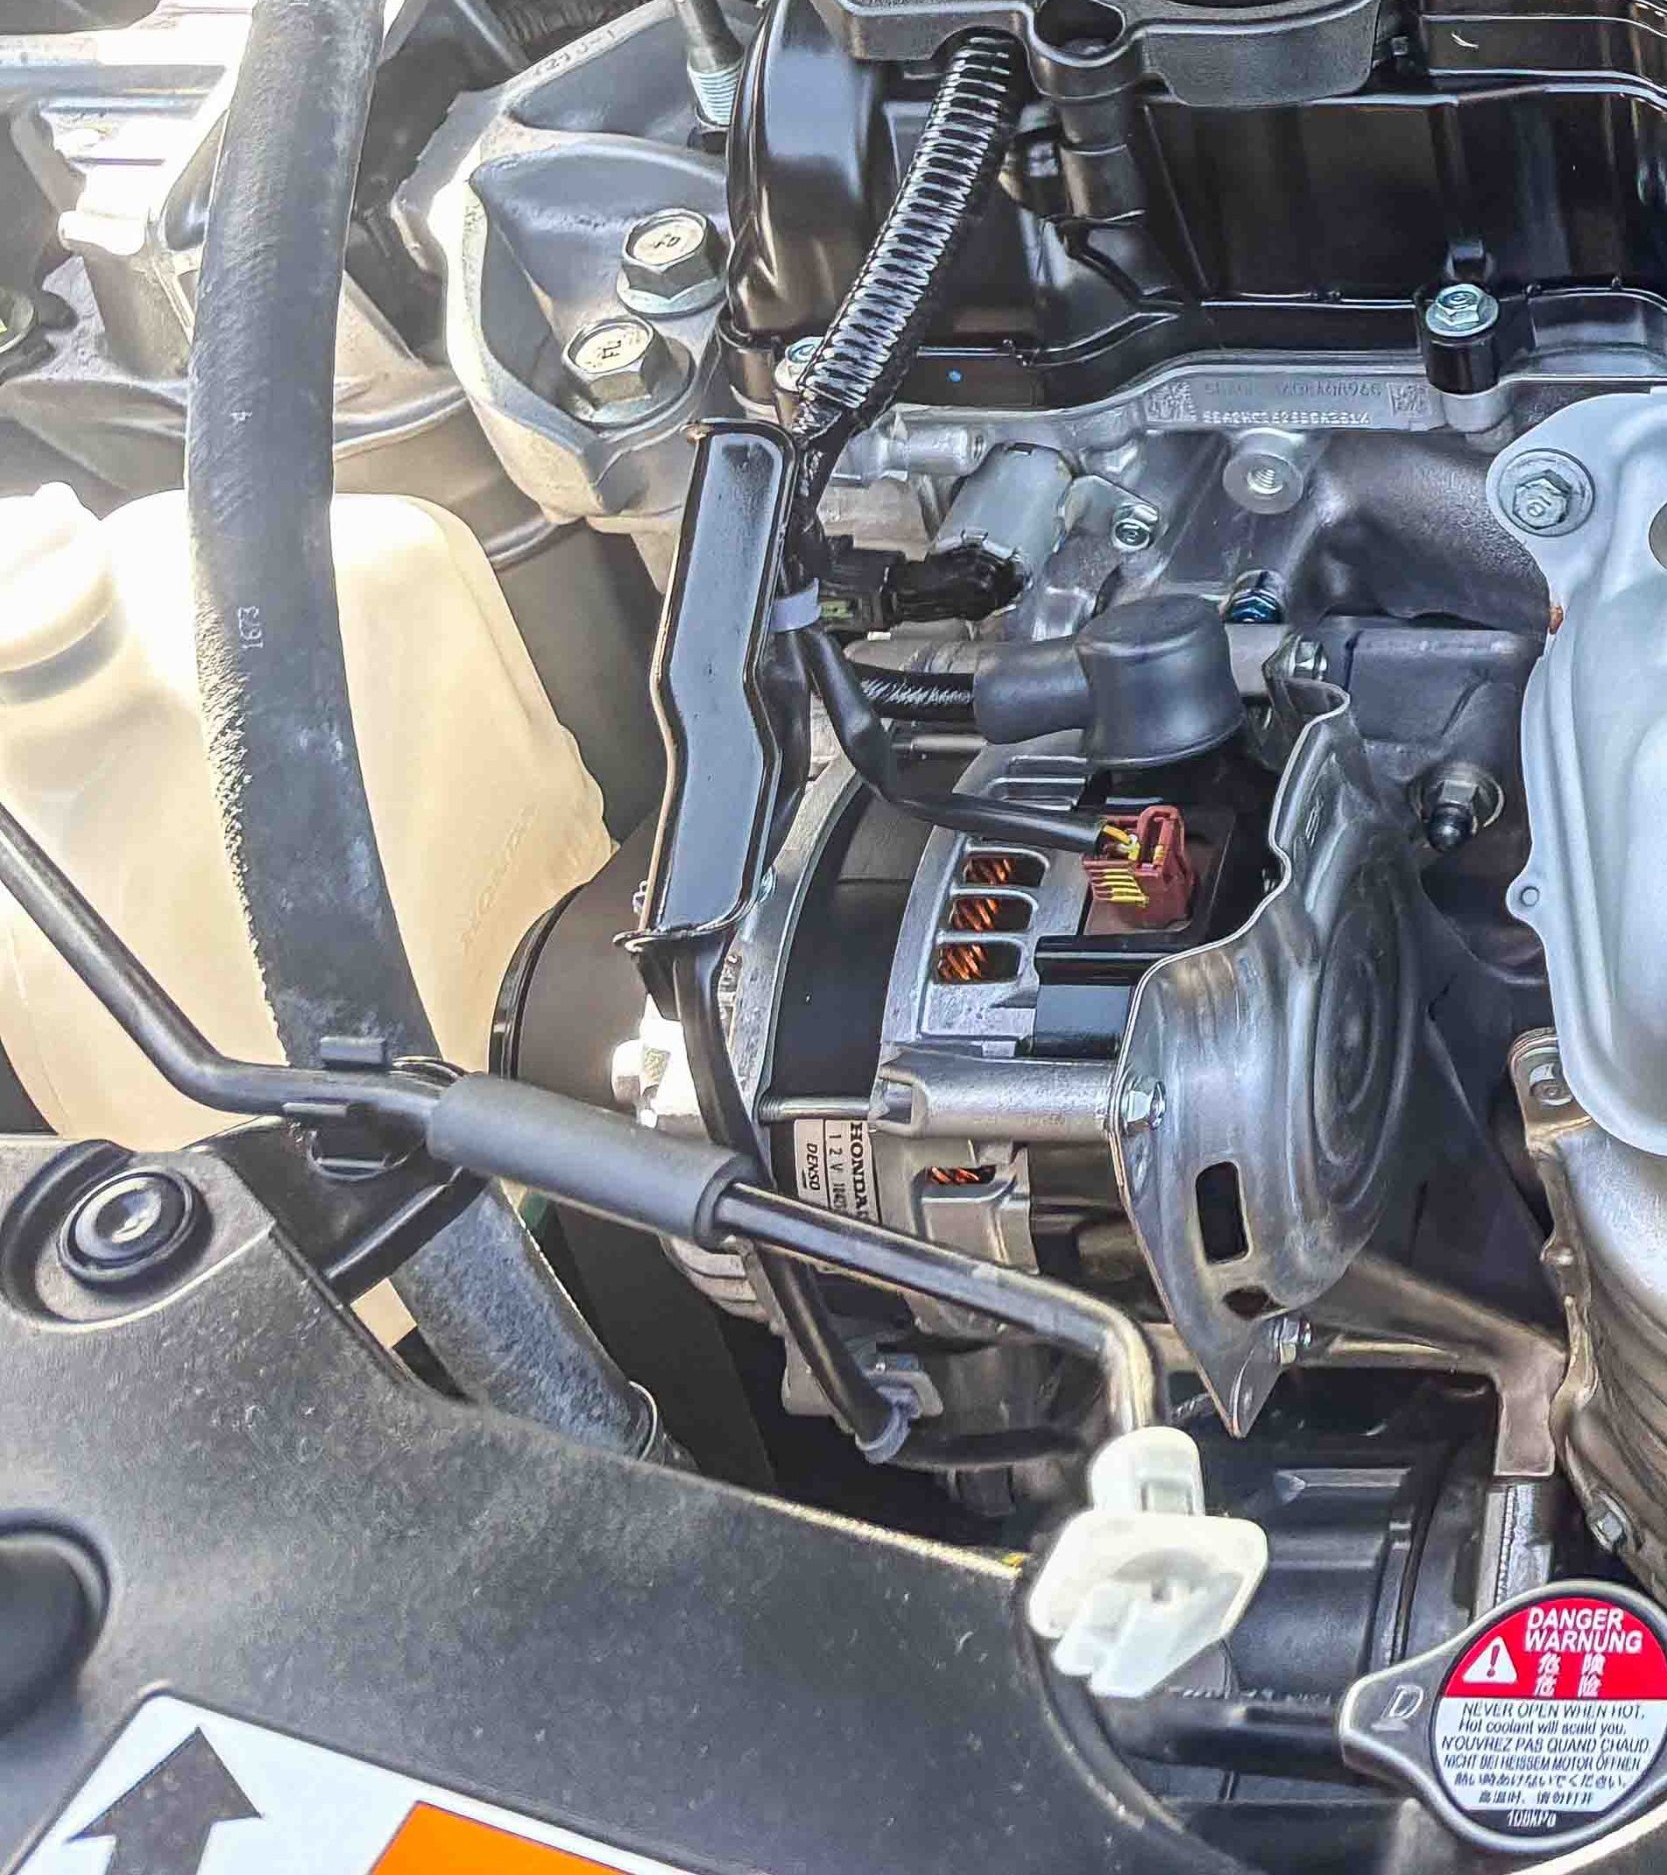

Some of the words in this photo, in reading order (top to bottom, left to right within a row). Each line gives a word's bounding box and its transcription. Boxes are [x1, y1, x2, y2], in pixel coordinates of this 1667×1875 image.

[806, 1142, 821, 1191] DENSO
[850, 1121, 869, 1210] HONDA
[1527, 1607, 1625, 1630] DANGER
[1525, 1628, 1643, 1653] WARNUNG
[1462, 1702, 1514, 1718] NEVER
[1517, 1703, 1559, 1719] OPEN
[1563, 1704, 1607, 1719] WHEN
[1459, 1718, 1482, 1733] Hot
[1486, 1719, 1534, 1734] coolant
[1537, 1721, 1558, 1734] will
[1562, 1721, 1596, 1735] scald
[1515, 1737, 1543, 1752] PAS
[1547, 1738, 1596, 1753] QUAND
[1444, 1755, 1476, 1769] NICHT
[1480, 1755, 1498, 1770] BEI
[1501, 1756, 1550, 1770] HEISSEM
[1552, 1757, 1593, 1771] MOTOR
